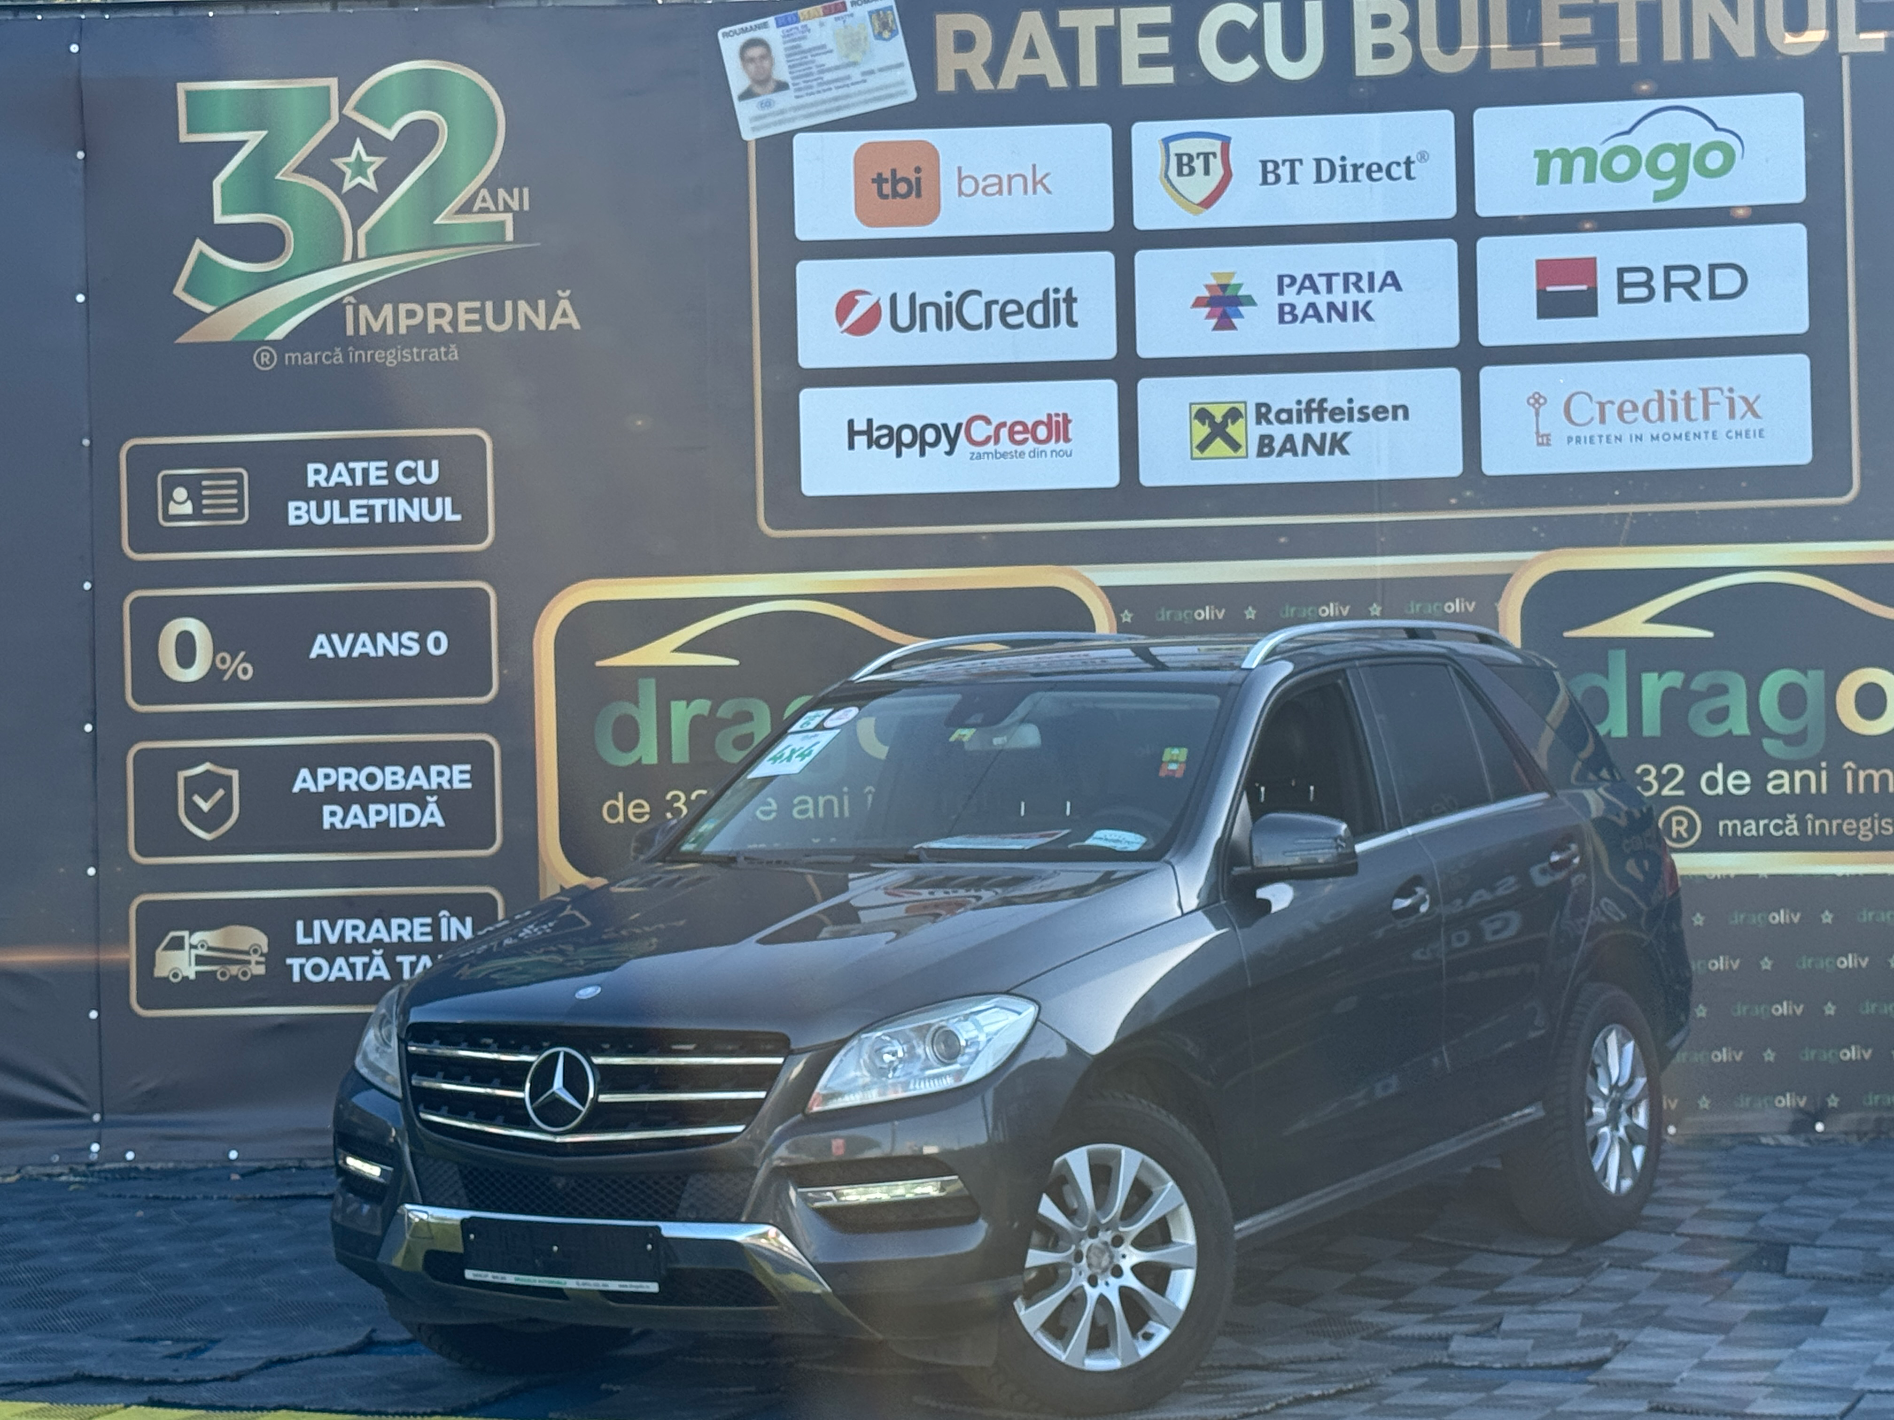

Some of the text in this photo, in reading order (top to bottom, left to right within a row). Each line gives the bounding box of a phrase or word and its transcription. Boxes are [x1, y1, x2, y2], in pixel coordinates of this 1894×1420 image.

[935, 7, 1176, 92] RATE
[1199, 1, 1326, 84] CU
[1353, 0, 1886, 76] BULETINUL
[1174, 151, 1217, 178] BT
[1258, 158, 1303, 187] BT
[1533, 139, 1737, 203] mogo
[173, 59, 514, 313] 32
[871, 163, 1053, 200] tbi bank
[472, 187, 530, 213] ANI
[1276, 270, 1403, 296] PATRIA
[1616, 262, 1749, 304] BRD
[344, 289, 581, 337] ÎMPREUNĂ
[889, 286, 1079, 334] UniCredit
[1277, 300, 1375, 325] BANK
[284, 346, 344, 367] marcă
[348, 344, 460, 368] înregistrată
[1254, 397, 1410, 426] Raiffeisen
[1563, 386, 1763, 428] CreditFix
[847, 412, 1073, 458] HappyCredit
[1256, 431, 1353, 458] BANK
[1566, 427, 1767, 446] PRIETEN IN MOMENTE CHEIE
[968, 447, 1073, 461] zambeste din nou
[307, 459, 439, 488] RATE CU
[288, 496, 462, 527] BULETINUL
[1155, 598, 1477, 625] dragoliv dragoliv dragoliv
[309, 630, 448, 660] AVANS 0
[1566, 649, 1894, 761] drago
[292, 764, 473, 794] APROBARE
[1635, 763, 1686, 797] 32
[1700, 762, 1752, 797] de
[1766, 761, 1828, 796] ani
[322, 795, 446, 831] RAPIDĂ
[602, 792, 651, 824] de
[1718, 813, 1799, 838] marcă
[296, 910, 474, 945] LIVRARE ÎN
[1728, 908, 1802, 928] dragoliv
[286, 949, 392, 983] TOATĂ
[1796, 953, 1870, 973] dragoliv
[1731, 1000, 1805, 1020] dragoliv
[1800, 1045, 1873, 1064] dragoliv
